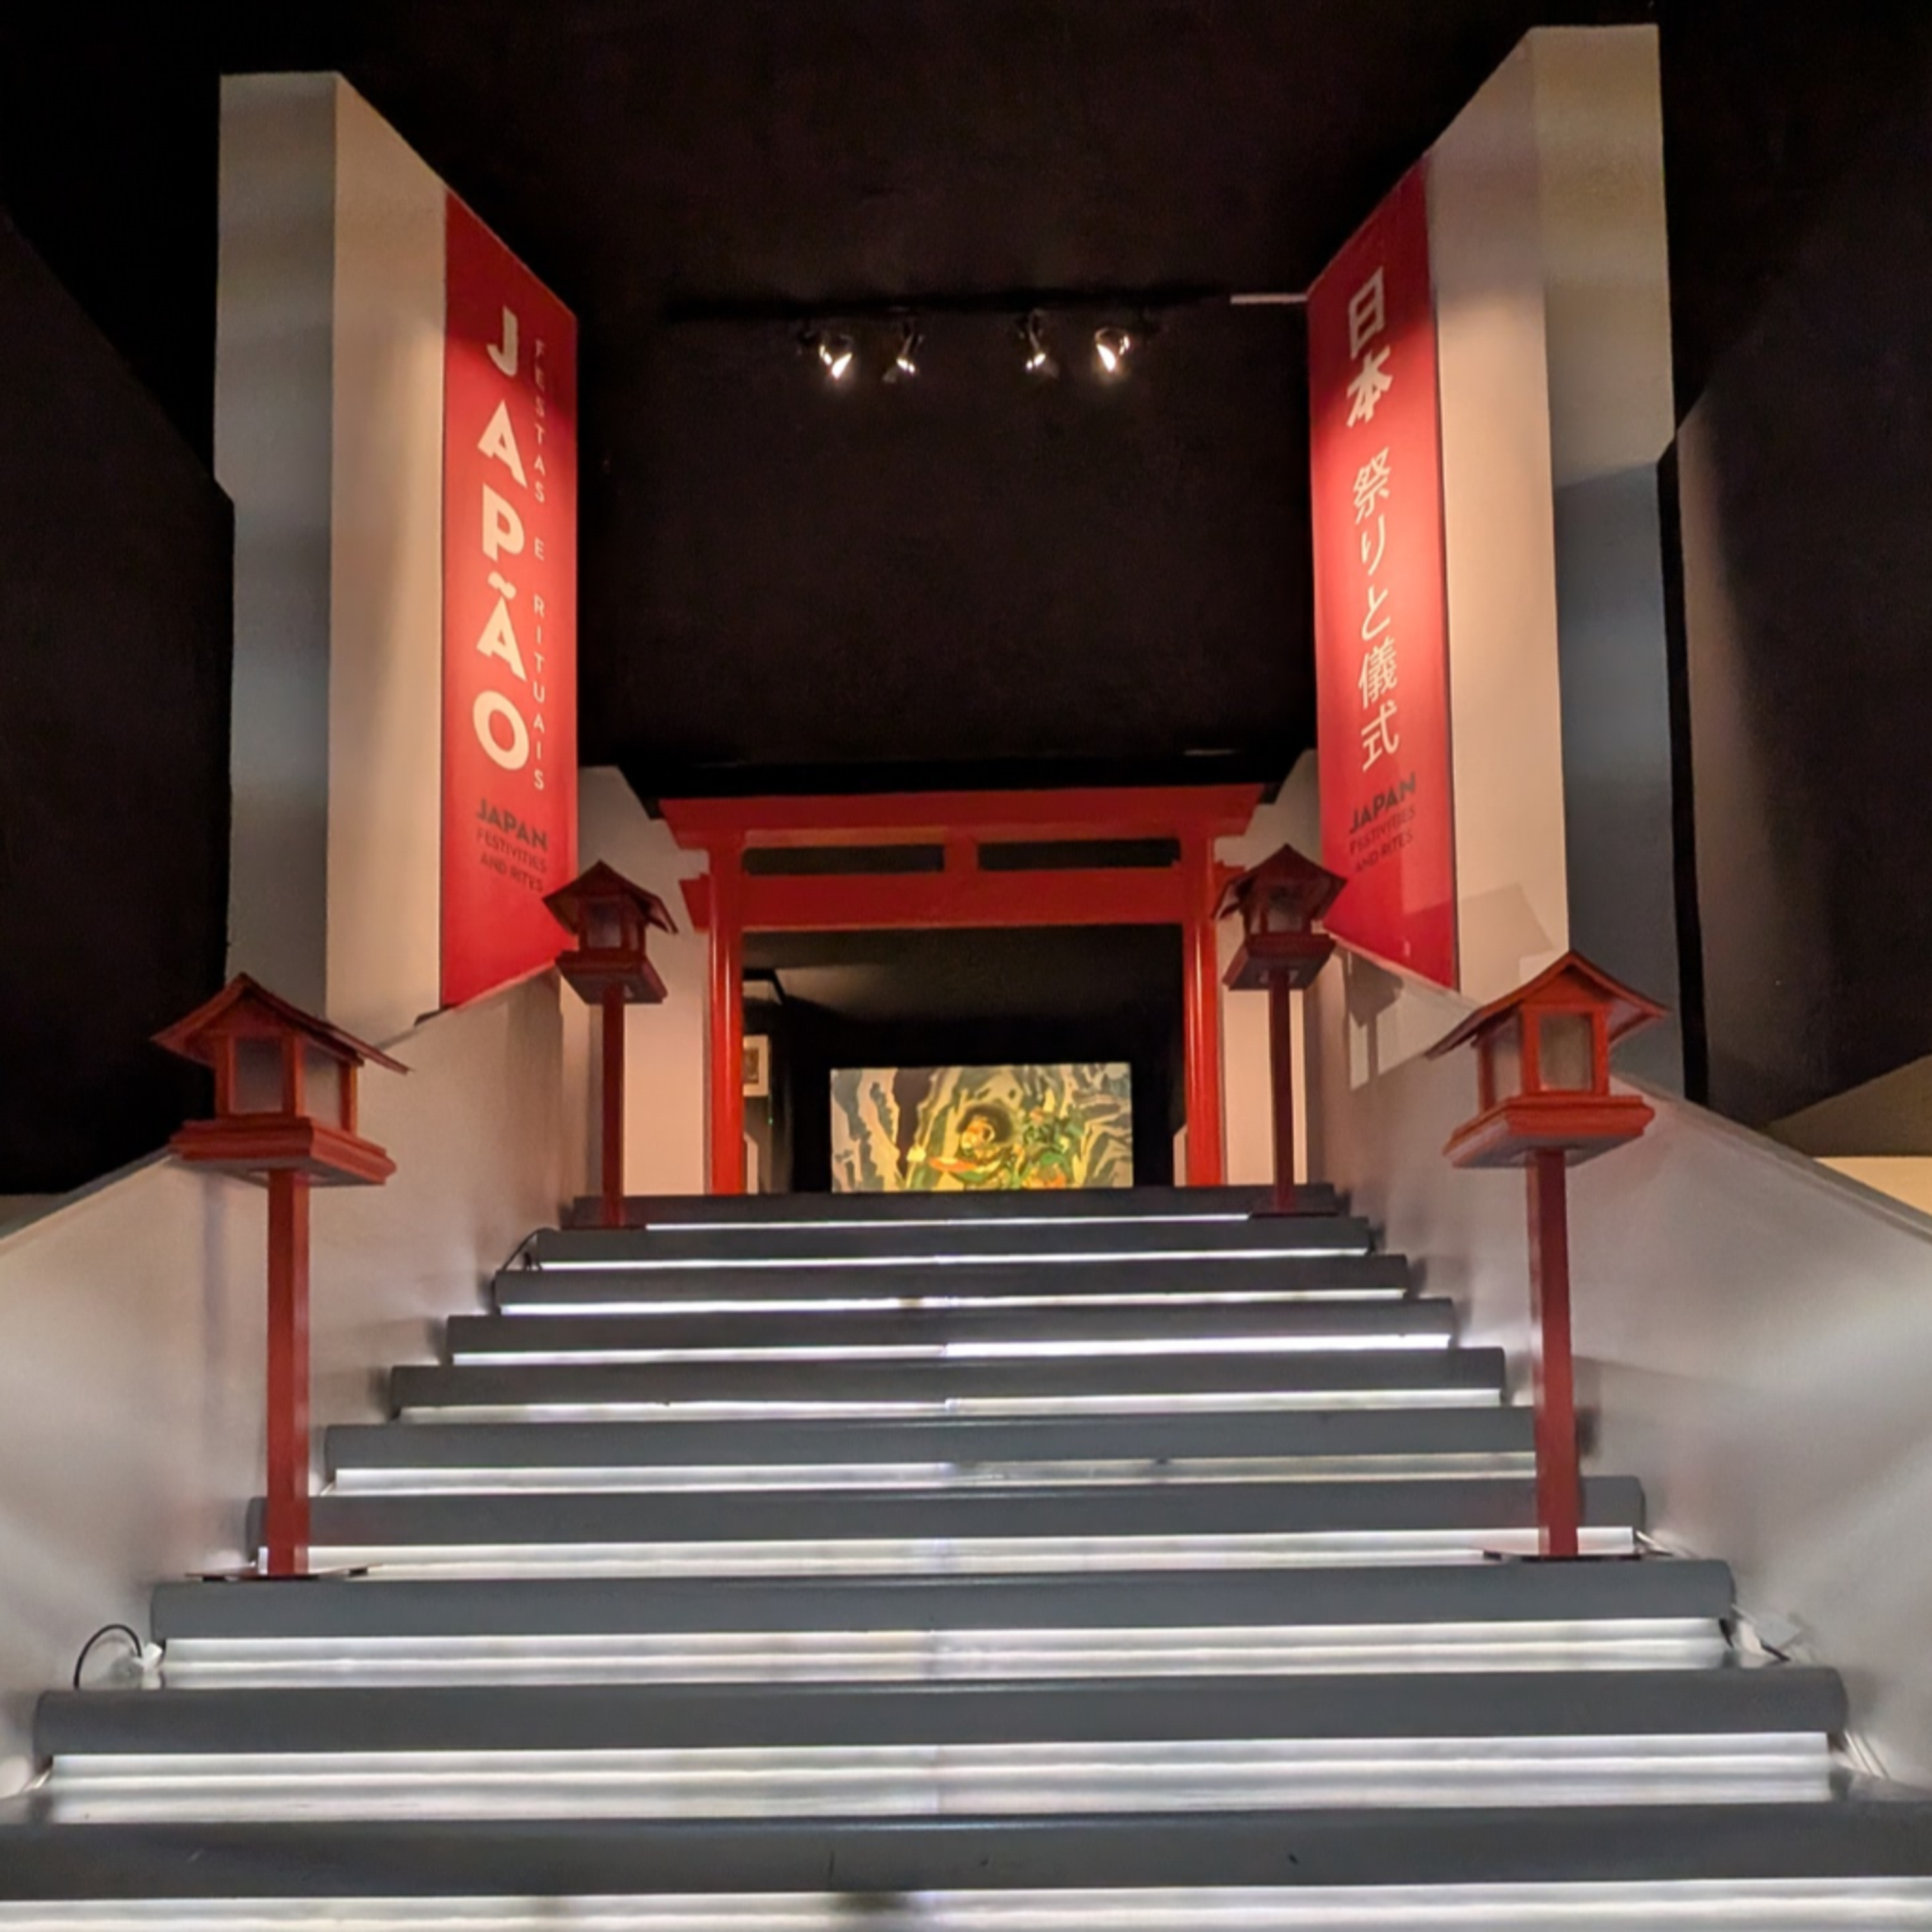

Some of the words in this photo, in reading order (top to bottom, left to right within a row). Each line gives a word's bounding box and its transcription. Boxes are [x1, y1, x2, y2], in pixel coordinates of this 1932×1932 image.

[534, 339, 545, 504] FESTAS
[1347, 265, 1393, 428] 日本
[473, 305, 529, 770] JAPÃO
[534, 537, 545, 561] E
[1353, 447, 1399, 772] 祭りと儀式
[533, 594, 545, 790] RITUAIS
[477, 799, 547, 853] JAPAN
[1350, 772, 1416, 834] JAPAN
